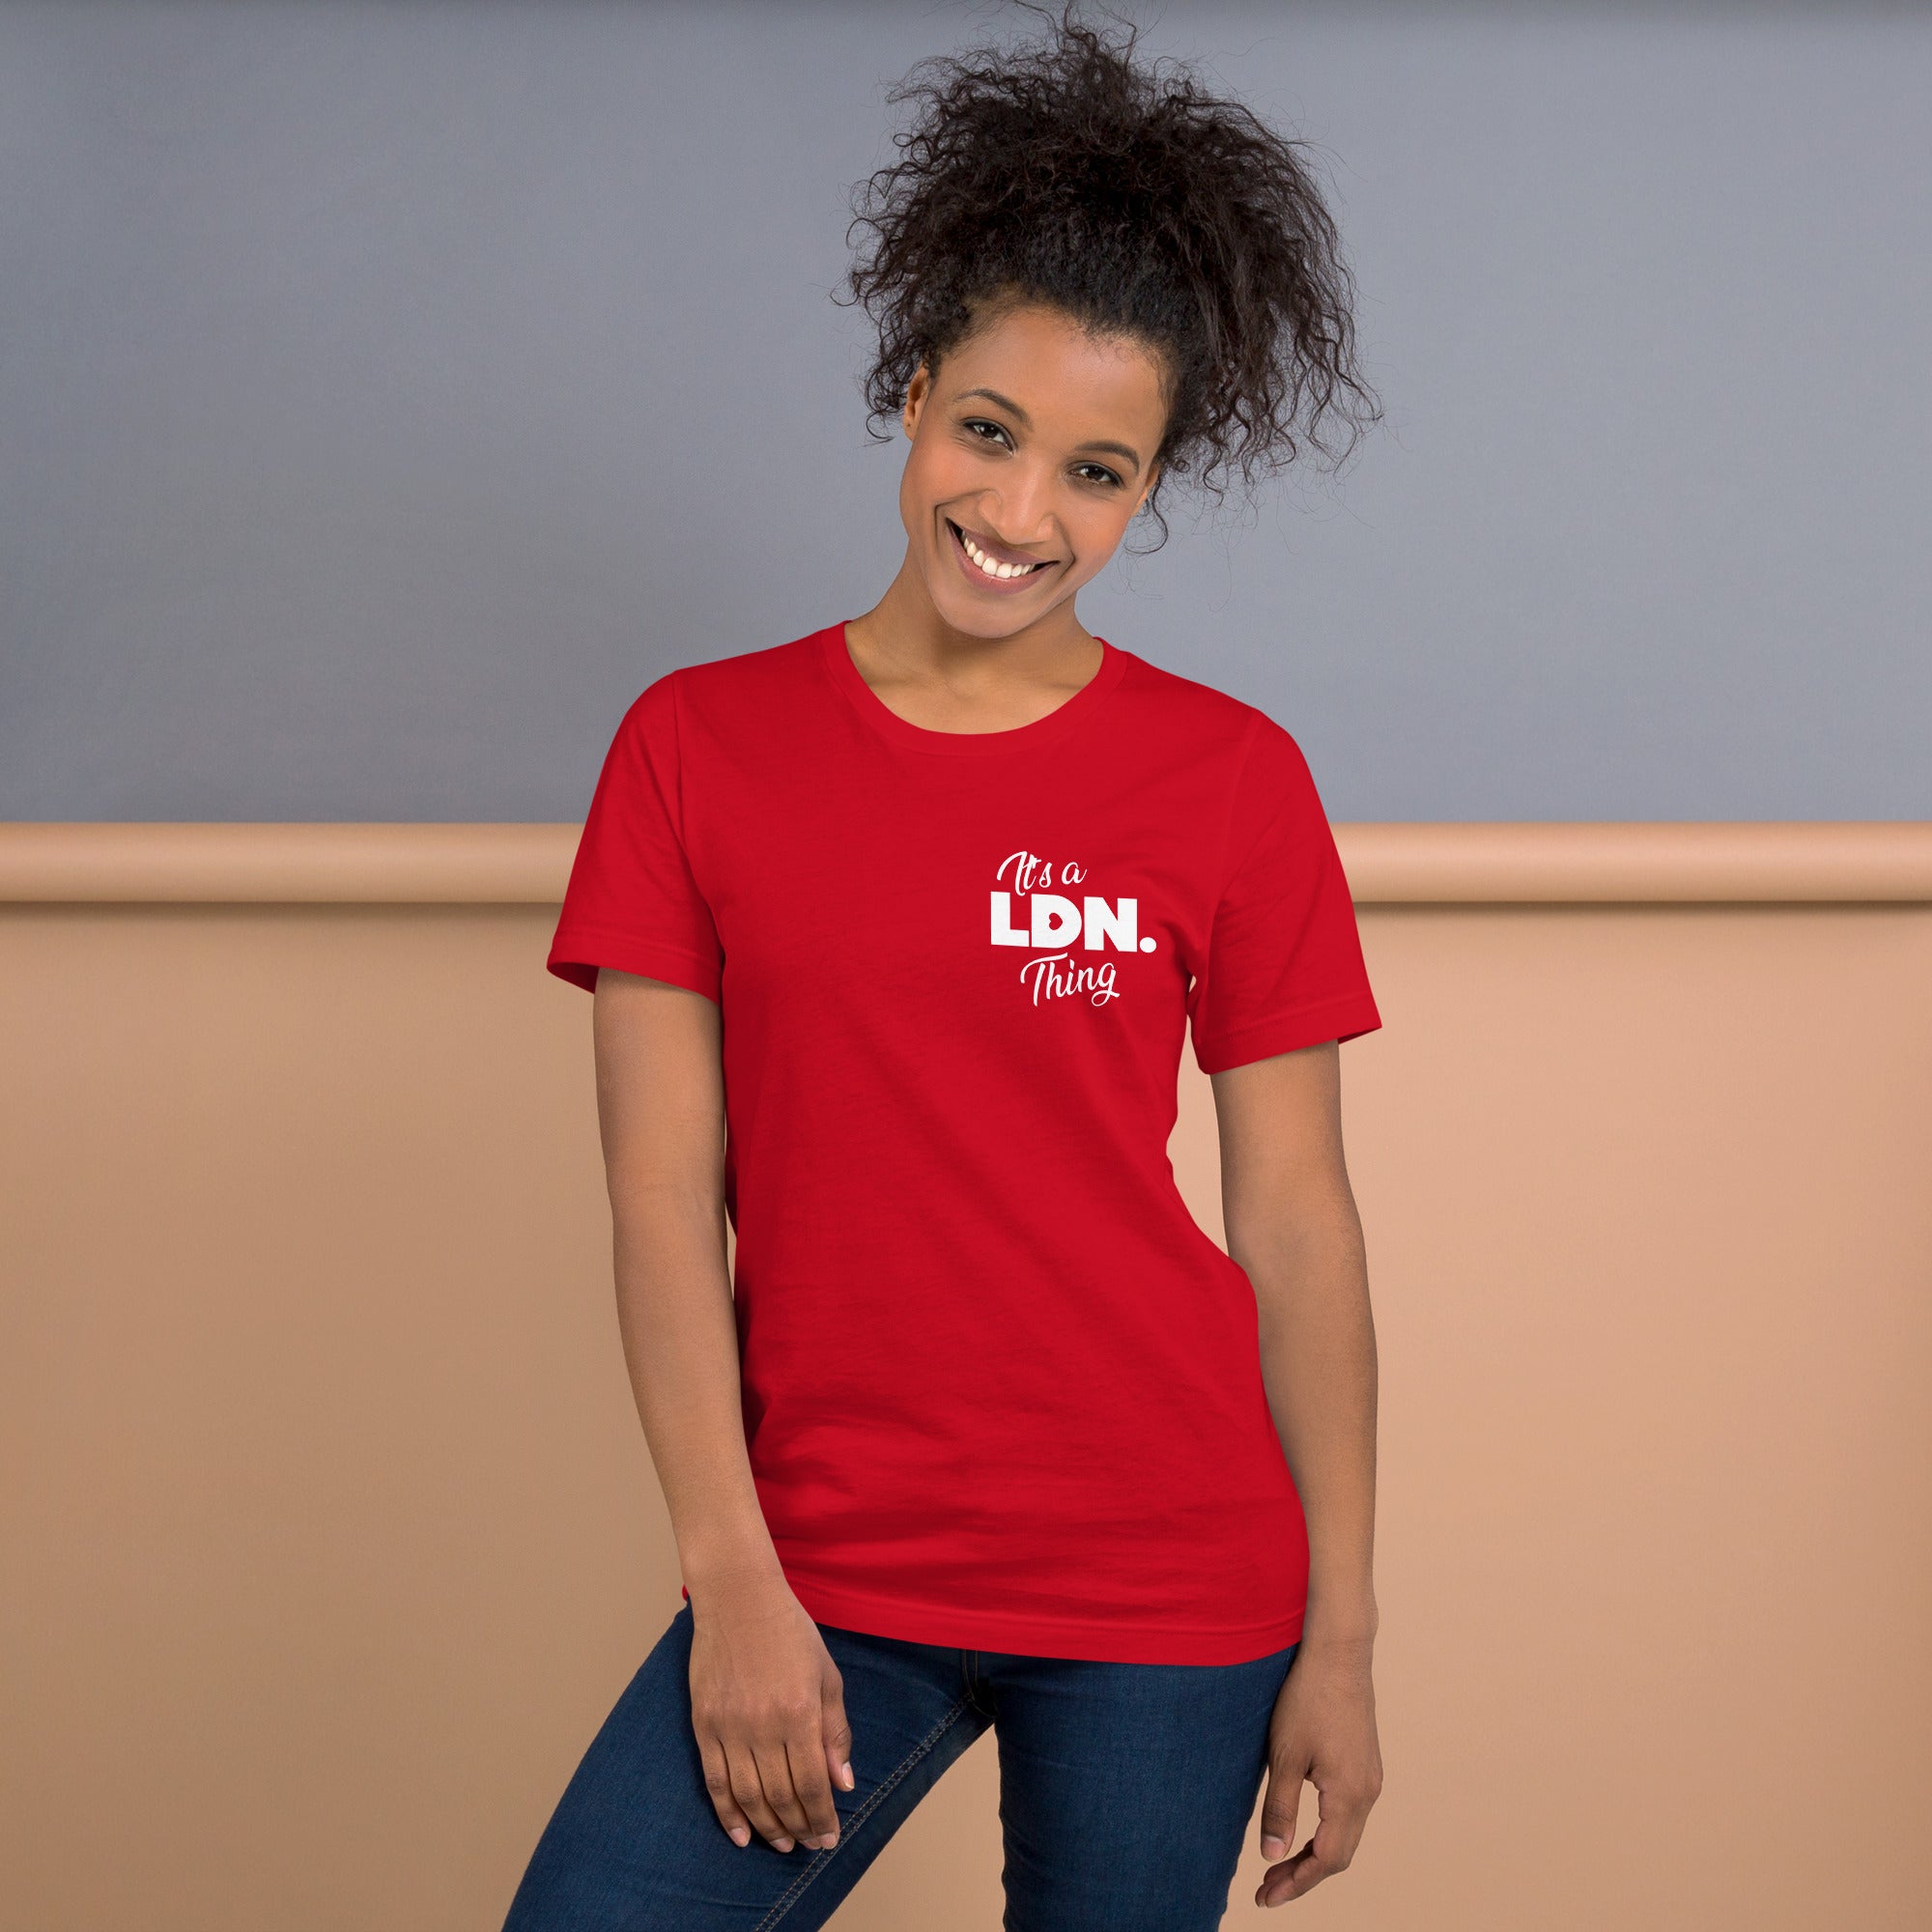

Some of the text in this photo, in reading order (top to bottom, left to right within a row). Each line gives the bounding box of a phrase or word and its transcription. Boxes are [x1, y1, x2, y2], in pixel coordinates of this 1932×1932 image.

[996, 850, 1088, 896] It's a
[990, 891, 1157, 953] LDN.
[1020, 952, 1121, 1007] Thing
